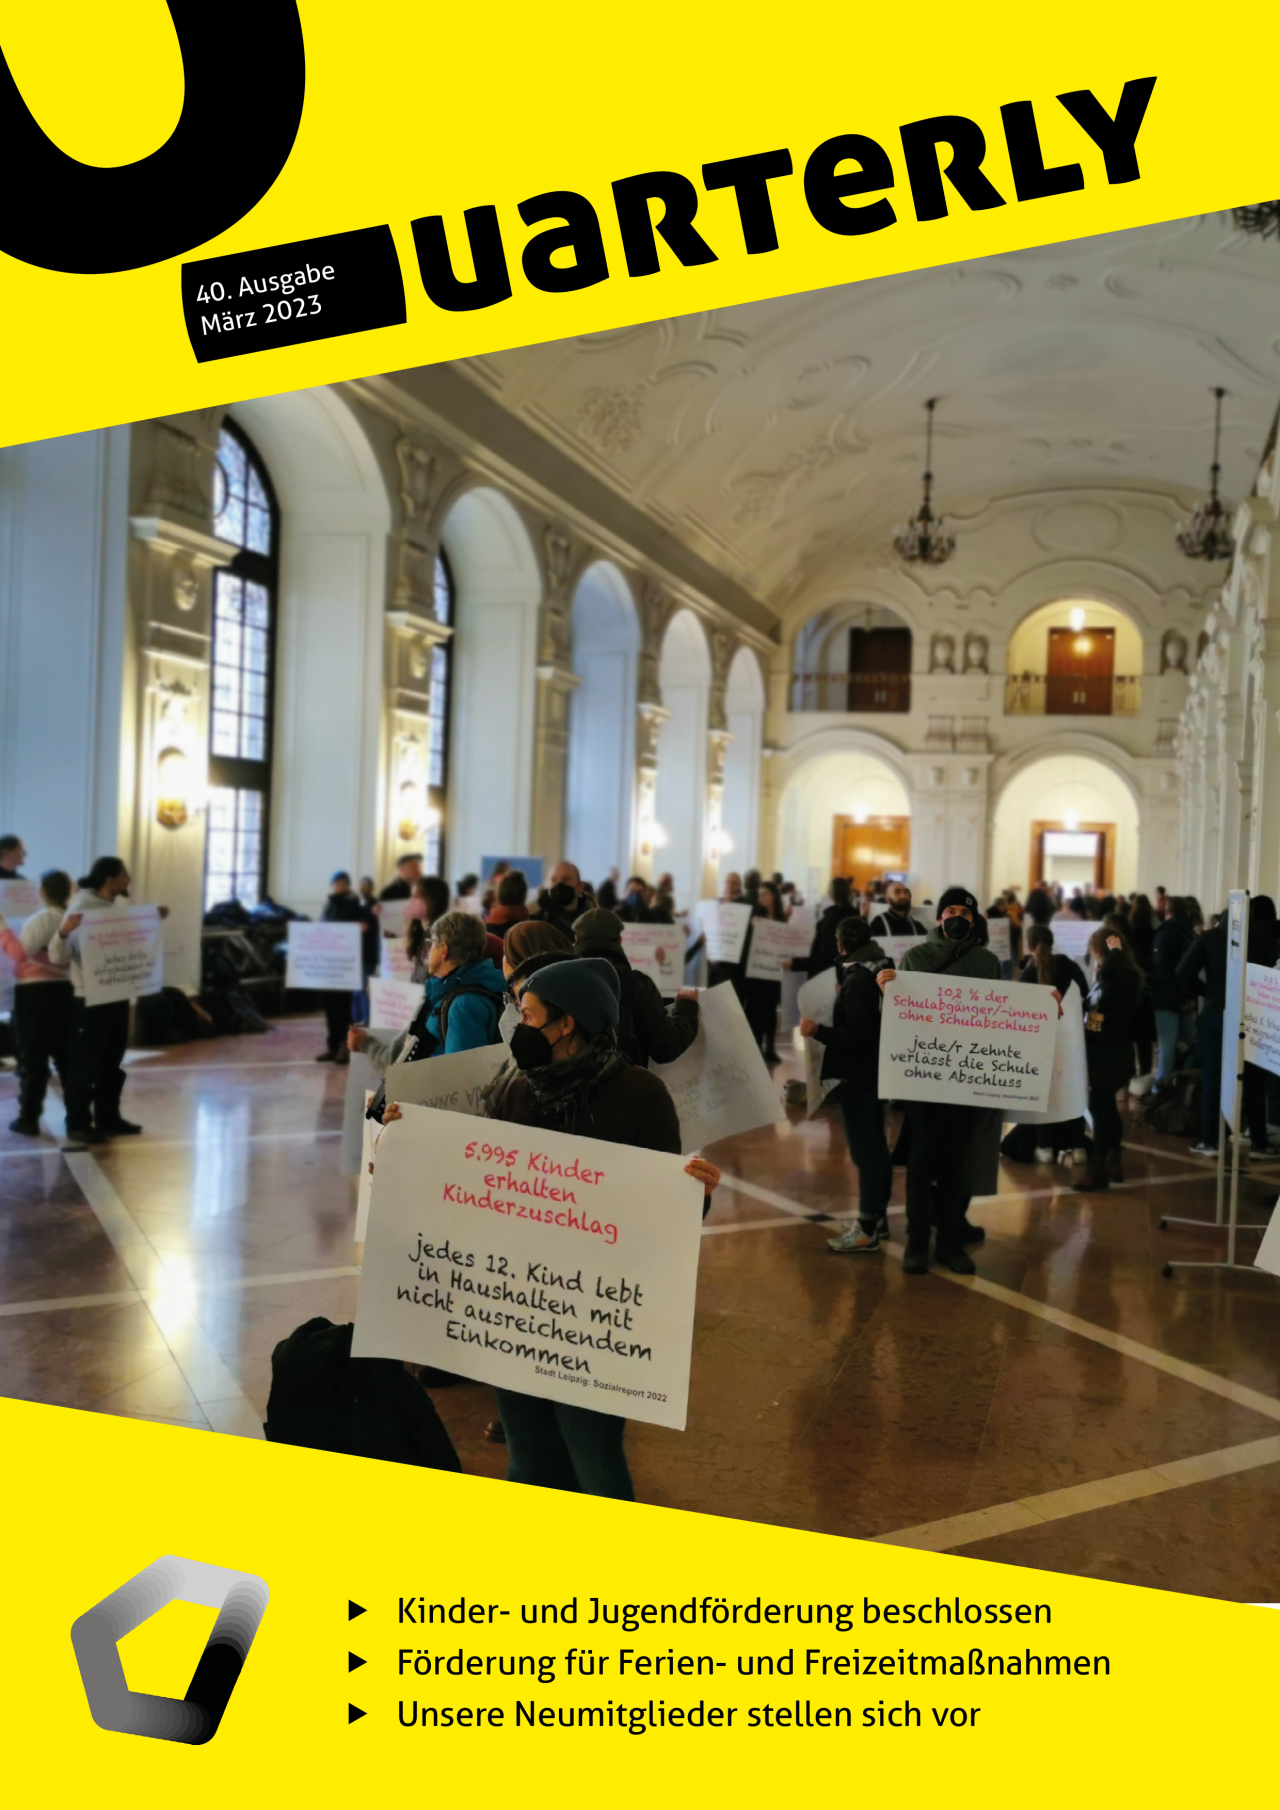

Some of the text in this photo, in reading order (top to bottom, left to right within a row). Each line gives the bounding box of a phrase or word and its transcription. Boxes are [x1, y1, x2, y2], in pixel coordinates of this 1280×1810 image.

[893, 995, 1048, 1021] Schulabgänger/-innen
[937, 987, 1009, 1004] 10,2 % der
[899, 1010, 1040, 1033] ohne Schulabschluss
[890, 1052, 952, 1067] verlässt
[958, 1055, 984, 1071] die
[992, 1060, 1039, 1076] Schule
[907, 1035, 1022, 1059] jede/r Zehnte
[904, 1066, 1022, 1089] ohne Abschluss
[464, 1141, 605, 1185] 5.995 Kinder
[484, 1171, 577, 1204] erhalten
[443, 1183, 618, 1245] Kinderzuschlag
[408, 1232, 643, 1307] jedes 12. Kind lebt
[418, 1262, 633, 1331] in Haushalten mit
[397, 1285, 652, 1361] nicht ausreichendem
[446, 1320, 591, 1374] Einkommen
[535, 1365, 668, 1402] Stadt Leipzig: Sozialreport 2022
